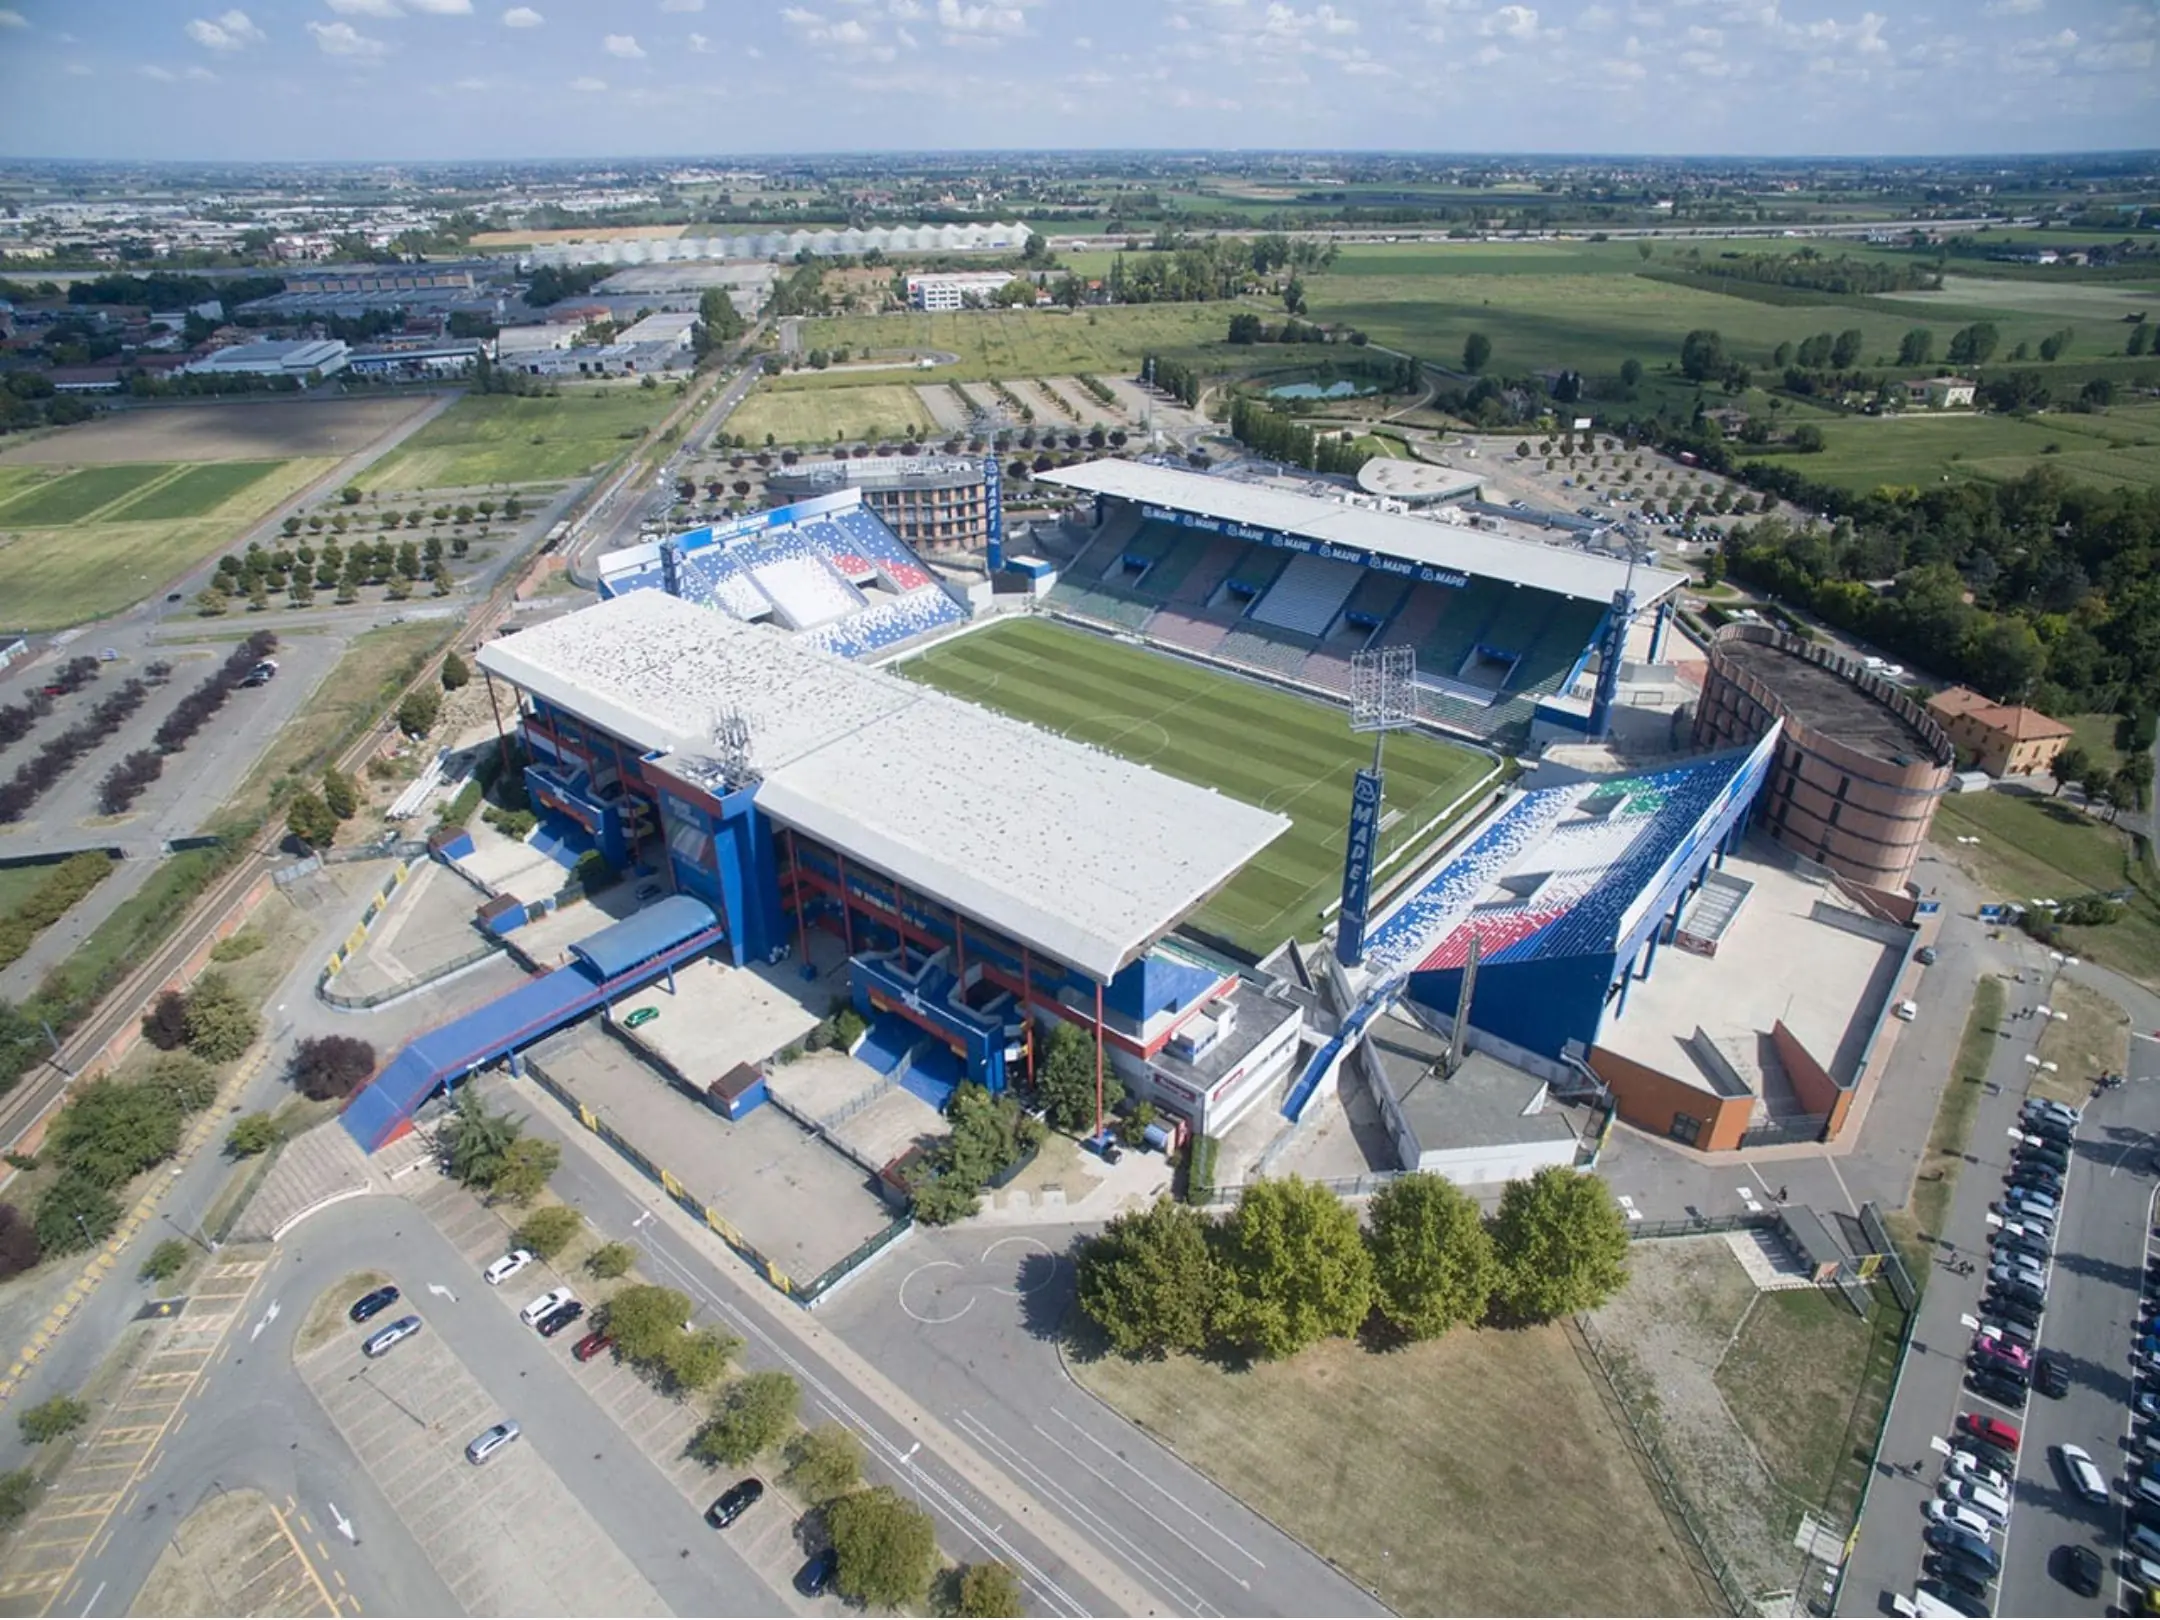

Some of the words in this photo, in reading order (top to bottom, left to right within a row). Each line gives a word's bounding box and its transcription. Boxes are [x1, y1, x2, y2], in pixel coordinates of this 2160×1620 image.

[1332, 548, 1361, 563] MAPEI
[1383, 560, 1413, 575] MAPEI
[1435, 571, 1468, 588] MAPEI
[1349, 803, 1373, 898] MAPEI
